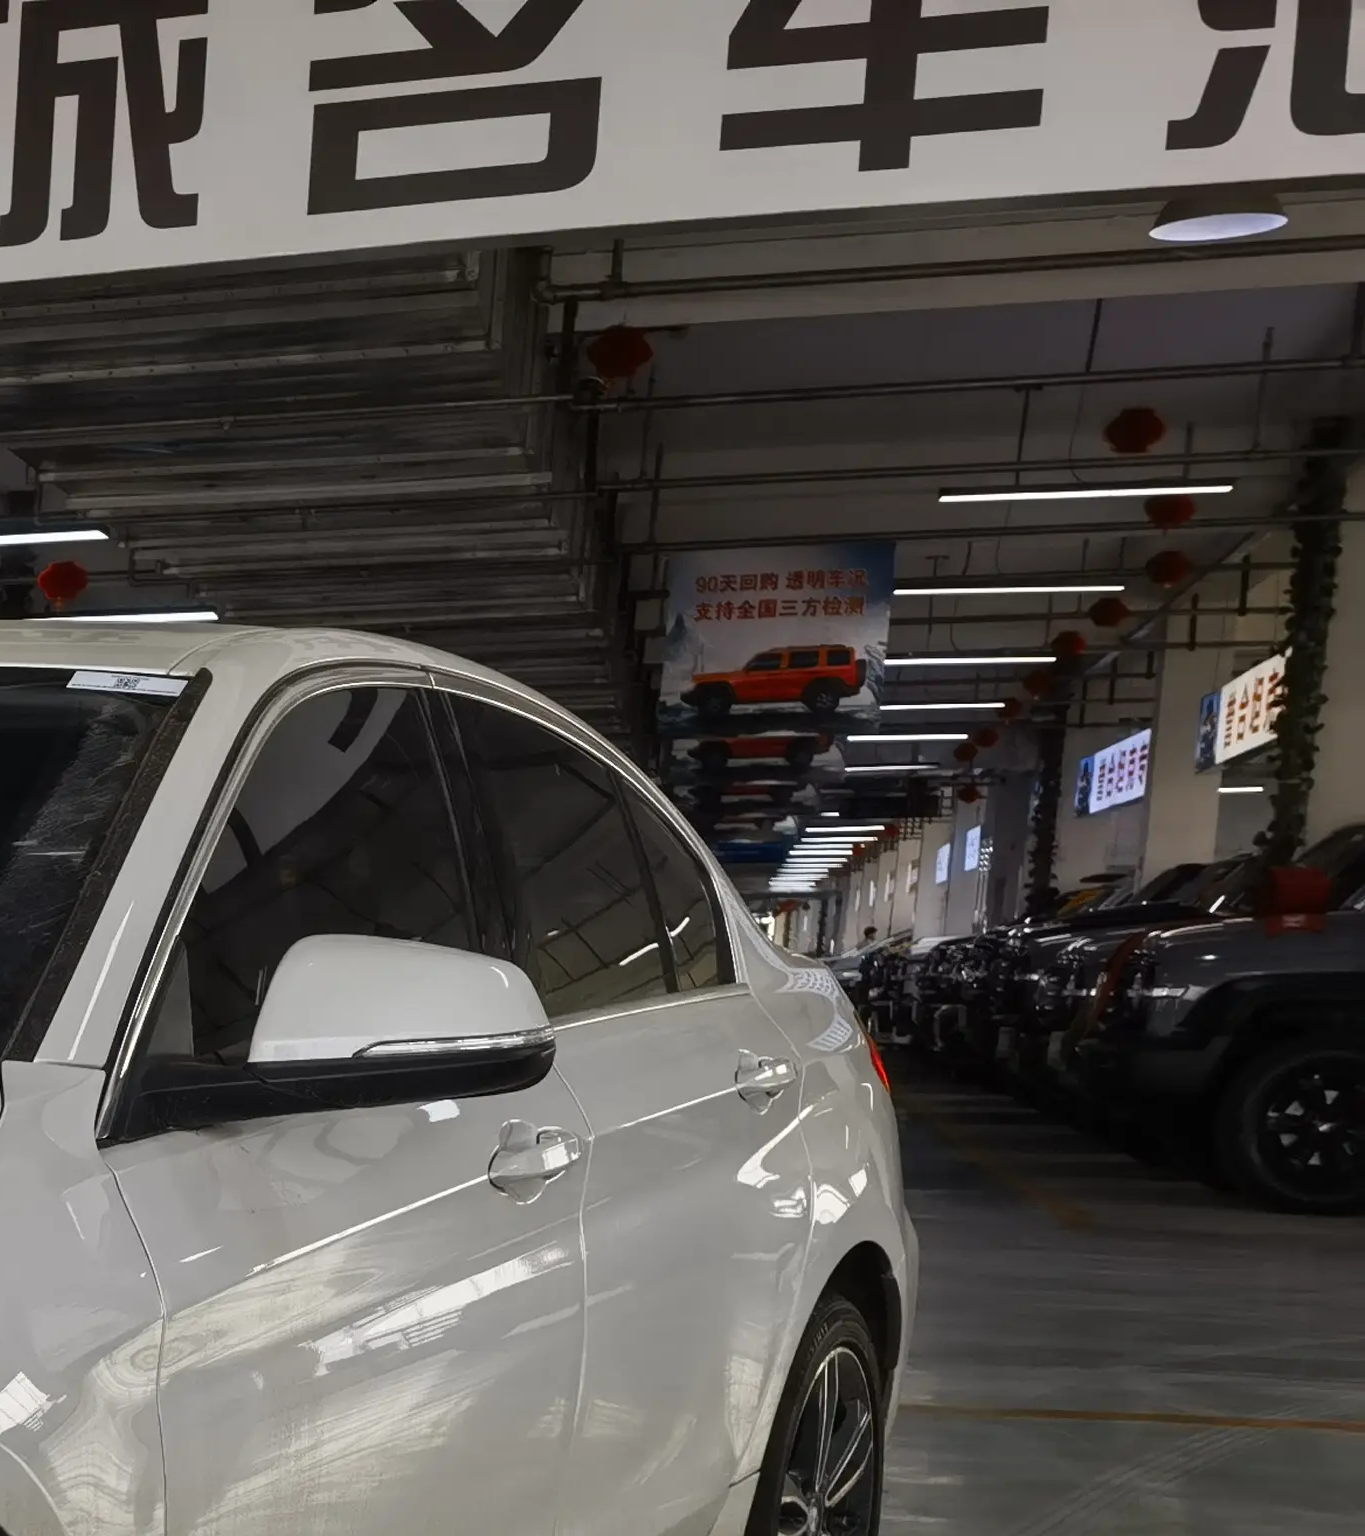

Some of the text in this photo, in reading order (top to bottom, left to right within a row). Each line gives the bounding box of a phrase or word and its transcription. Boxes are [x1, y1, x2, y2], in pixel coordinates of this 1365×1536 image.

[694, 596, 866, 622] 支持全国三方检测
